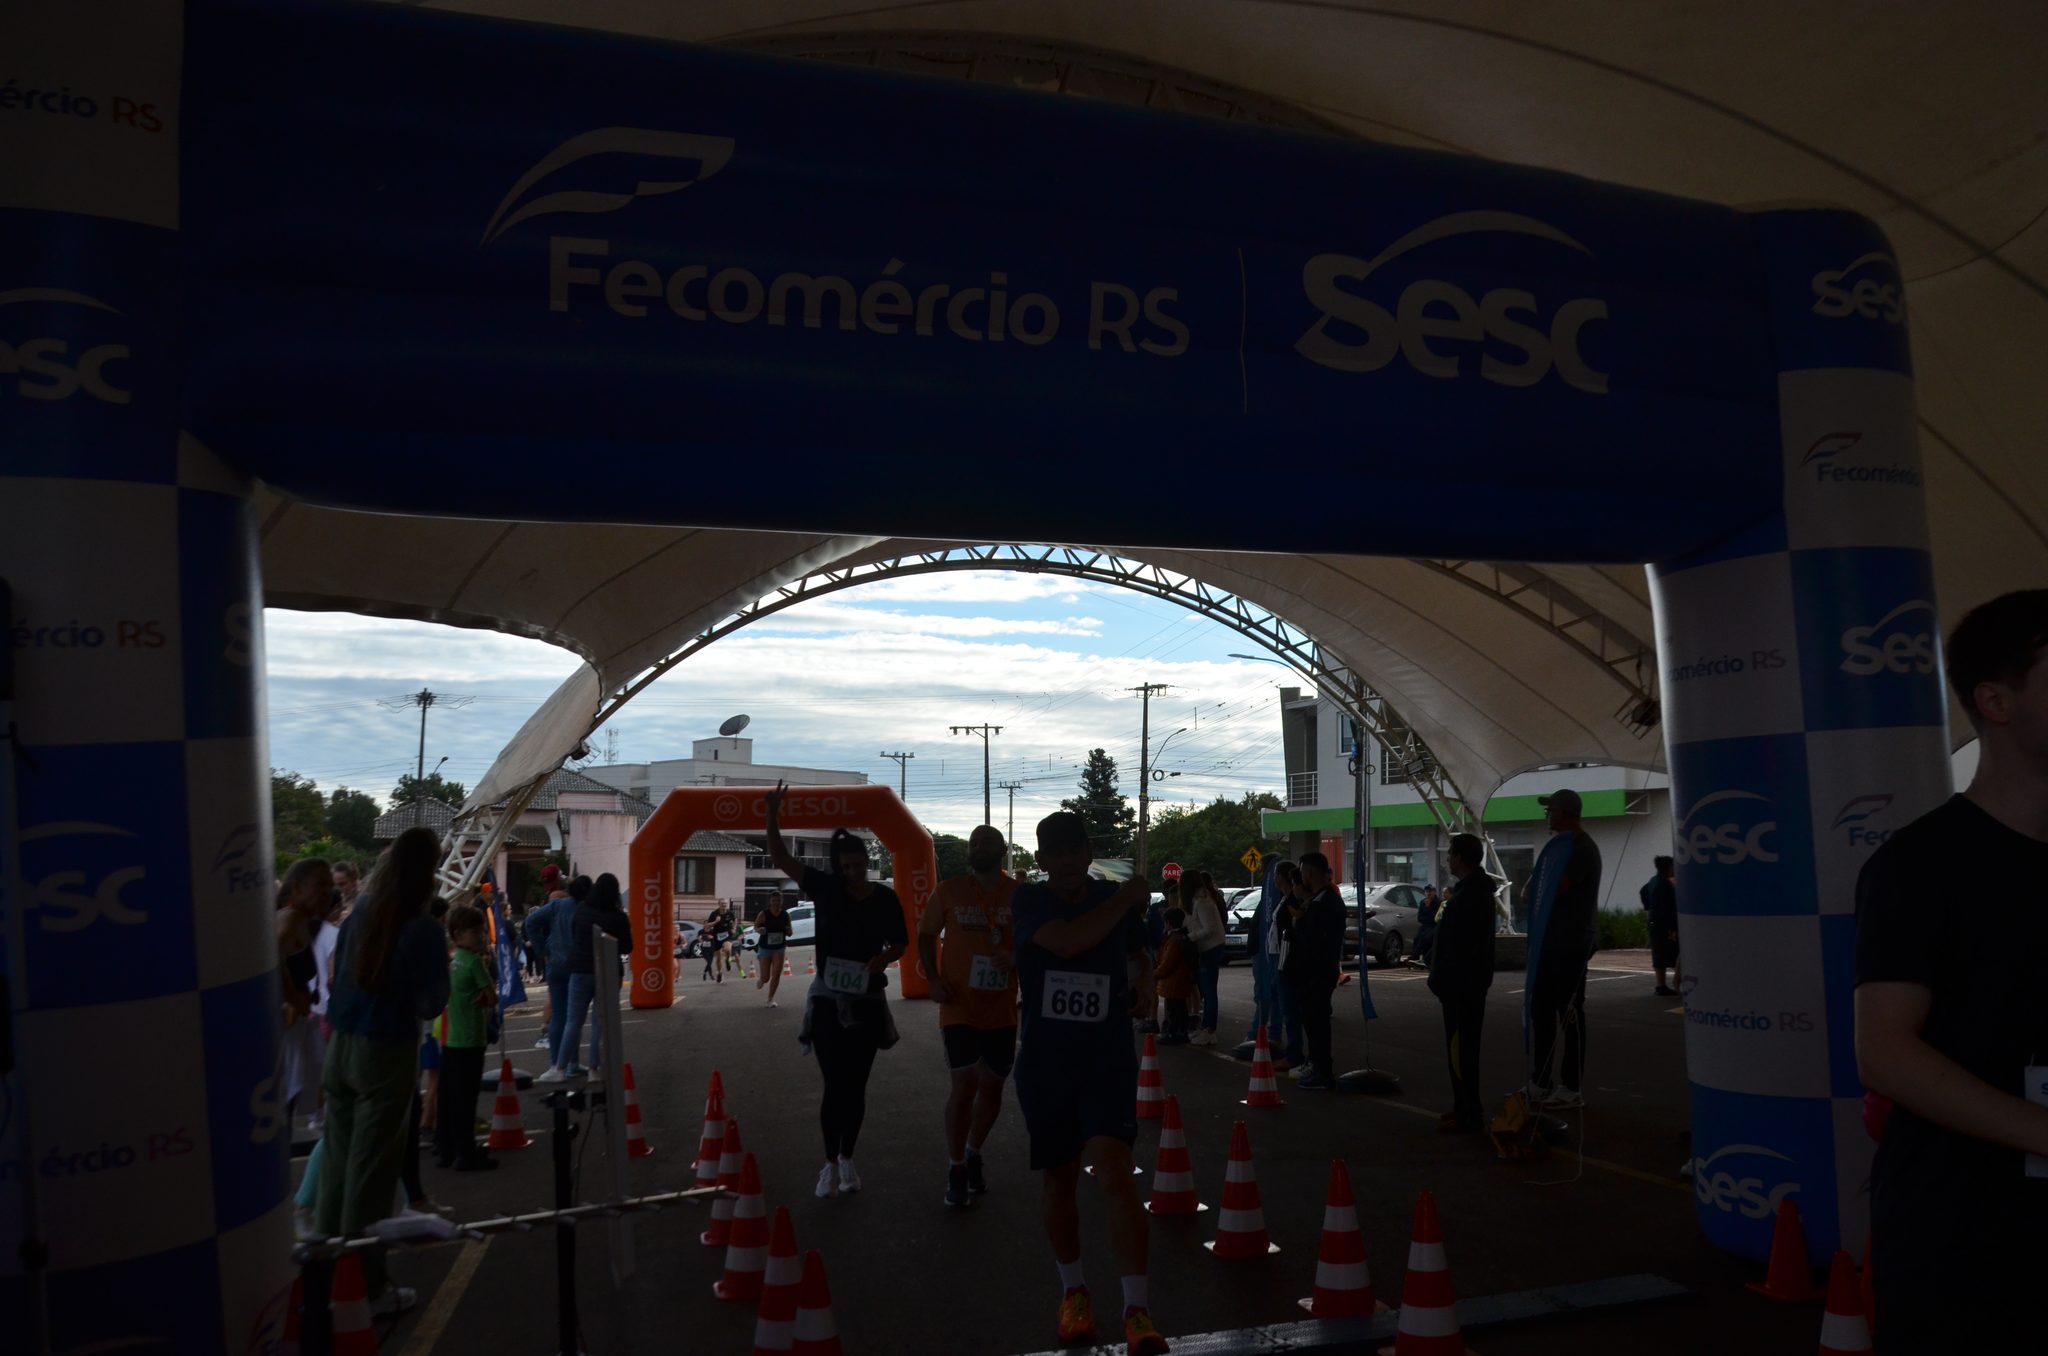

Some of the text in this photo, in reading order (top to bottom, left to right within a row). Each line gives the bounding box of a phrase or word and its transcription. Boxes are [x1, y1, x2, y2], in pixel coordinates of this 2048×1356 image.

[112, 96, 163, 132] RS
[548, 235, 1191, 358] Fecomércio RS
[1294, 240, 1610, 394] Sesc
[117, 620, 166, 649] RS
[1751, 649, 1787, 671] RS
[1163, 869, 1181, 877] PARE
[643, 871, 662, 962] CRESOL
[830, 970, 864, 991] 104
[1051, 989, 1100, 1018] 668
[1779, 1011, 1815, 1032] RS
[147, 1128, 195, 1162] RS
